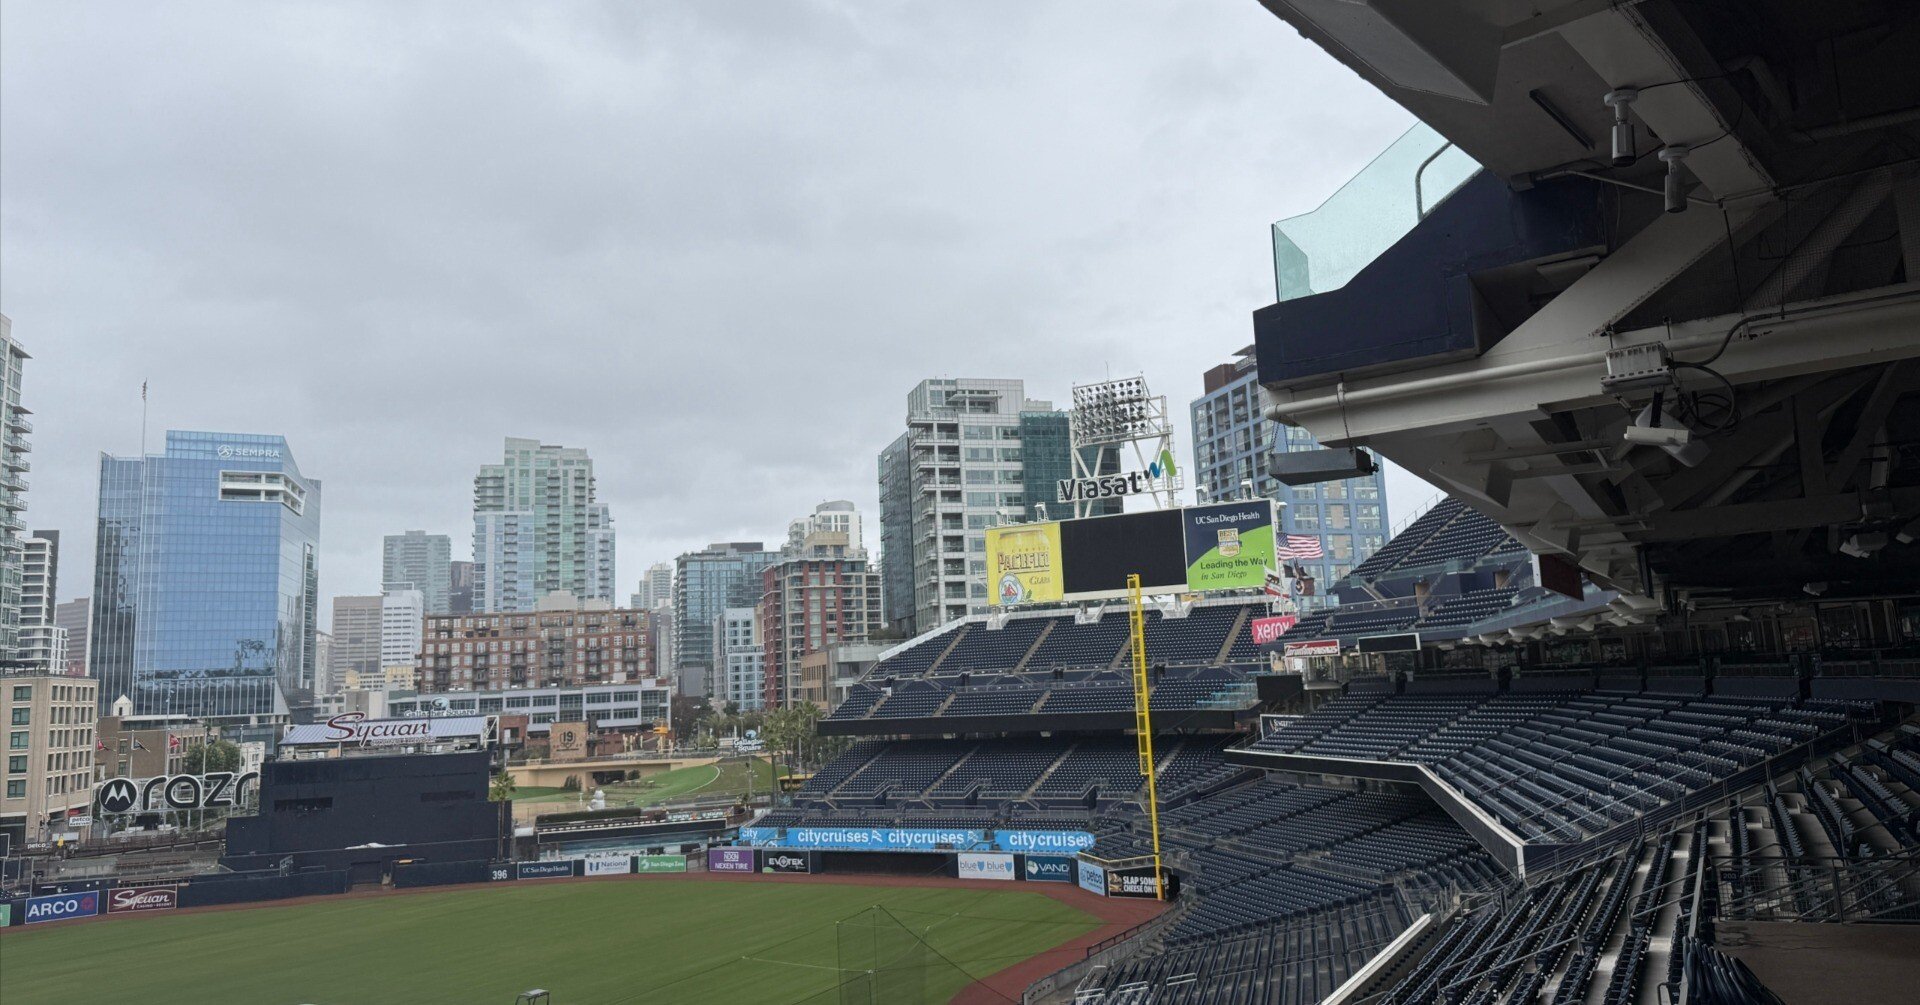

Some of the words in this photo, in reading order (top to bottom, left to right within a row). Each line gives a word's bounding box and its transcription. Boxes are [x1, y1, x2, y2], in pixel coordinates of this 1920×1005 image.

[235, 447, 280, 458] SEMPRA
[1059, 471, 1142, 501] Viasat
[1195, 516, 1206, 525] UC
[1206, 515, 1220, 524] San
[1219, 514, 1239, 523] Diego
[1238, 511, 1260, 521] Health
[1200, 561, 1234, 570] Leading
[1235, 559, 1248, 567] the
[1249, 557, 1268, 566] Way
[1210, 572, 1225, 580] San
[1227, 570, 1247, 578] Diego
[1256, 621, 1290, 640] xerox
[325, 711, 430, 747] Sycuan
[563, 731, 573, 742] 19
[142, 772, 259, 811] razr
[742, 828, 758, 840] city
[798, 829, 869, 845] citycruises
[888, 831, 965, 846] citycruises
[1009, 832, 1089, 849] citycruises
[600, 860, 628, 868] National
[735, 862, 749, 870] TIRE
[769, 856, 805, 868] EVOTEK
[960, 861, 977, 869] blue
[986, 861, 1004, 870] blue
[492, 869, 508, 880] 396
[1122, 875, 1139, 885] SLAP
[1123, 884, 1143, 893] CHEESE
[1143, 885, 1152, 894] ON
[113, 890, 170, 910] Sycuan
[28, 900, 78, 918] ARCO
